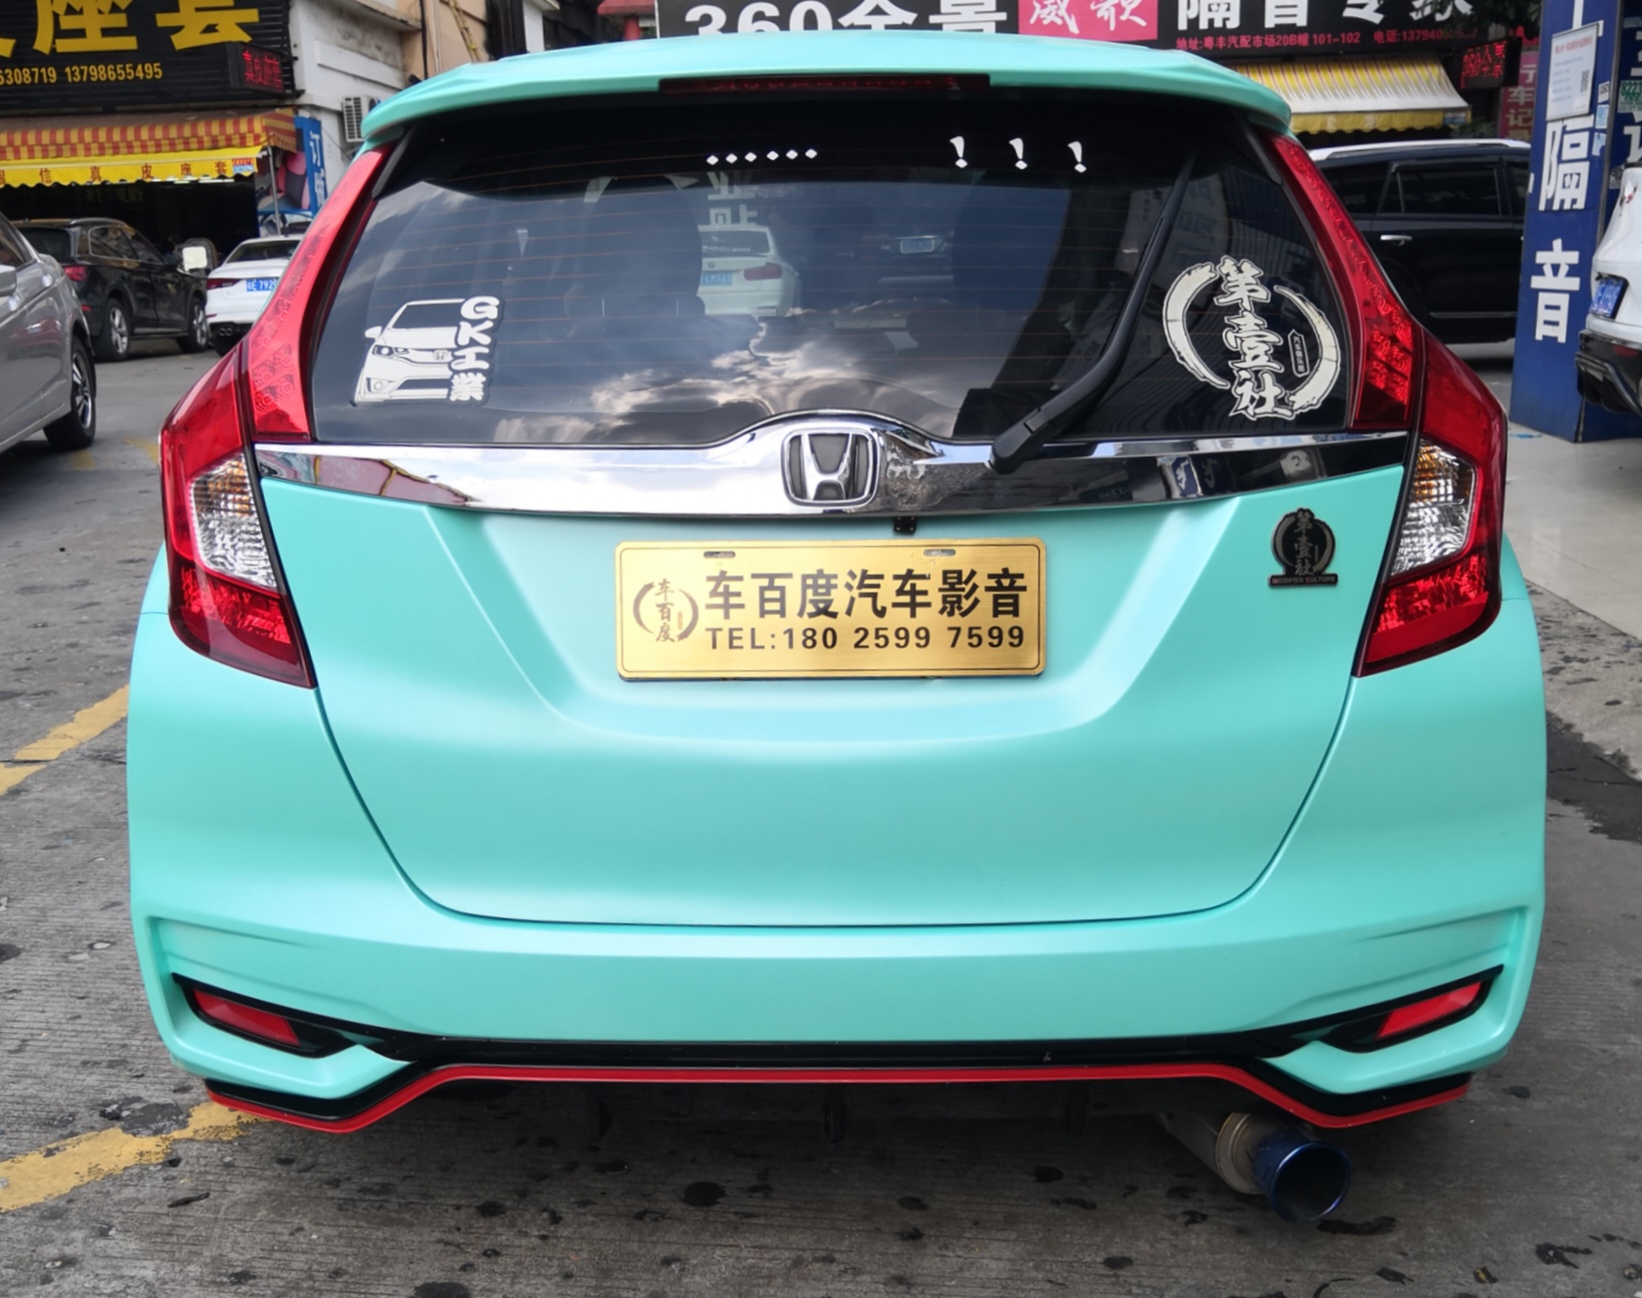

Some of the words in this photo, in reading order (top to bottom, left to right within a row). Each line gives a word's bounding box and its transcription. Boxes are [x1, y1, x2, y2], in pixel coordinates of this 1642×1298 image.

[0, 0, 259, 57] 座套
[1312, 32, 1360, 45] 101-102
[65, 63, 163, 82] 13798655495
[1214, 255, 1294, 421] 第壹社
[655, 578, 675, 642] 车百度
[705, 568, 1027, 620] 车百度汽车影音
[705, 627, 838, 650] TEL:180
[853, 627, 931, 649] 2599
[947, 626, 1025, 648] 7599
